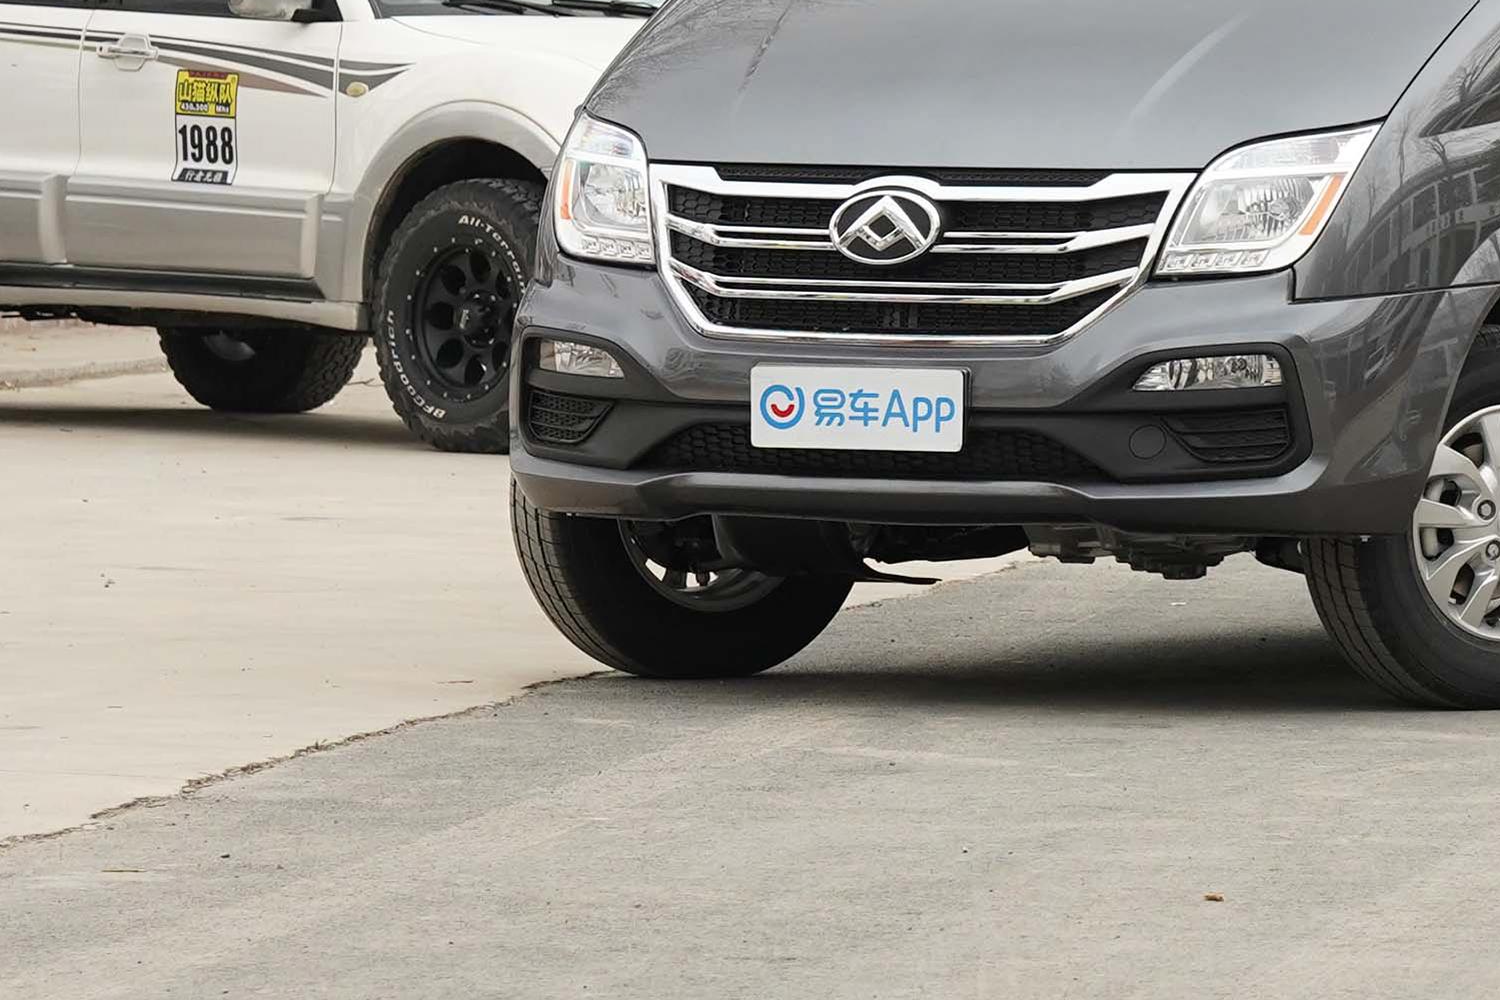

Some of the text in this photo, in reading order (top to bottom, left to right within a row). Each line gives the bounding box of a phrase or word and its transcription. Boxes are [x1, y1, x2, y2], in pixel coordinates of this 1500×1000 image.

[179, 79, 233, 104] 山猫纵队
[178, 124, 234, 165] 1988
[813, 388, 956, 433] 易车App
